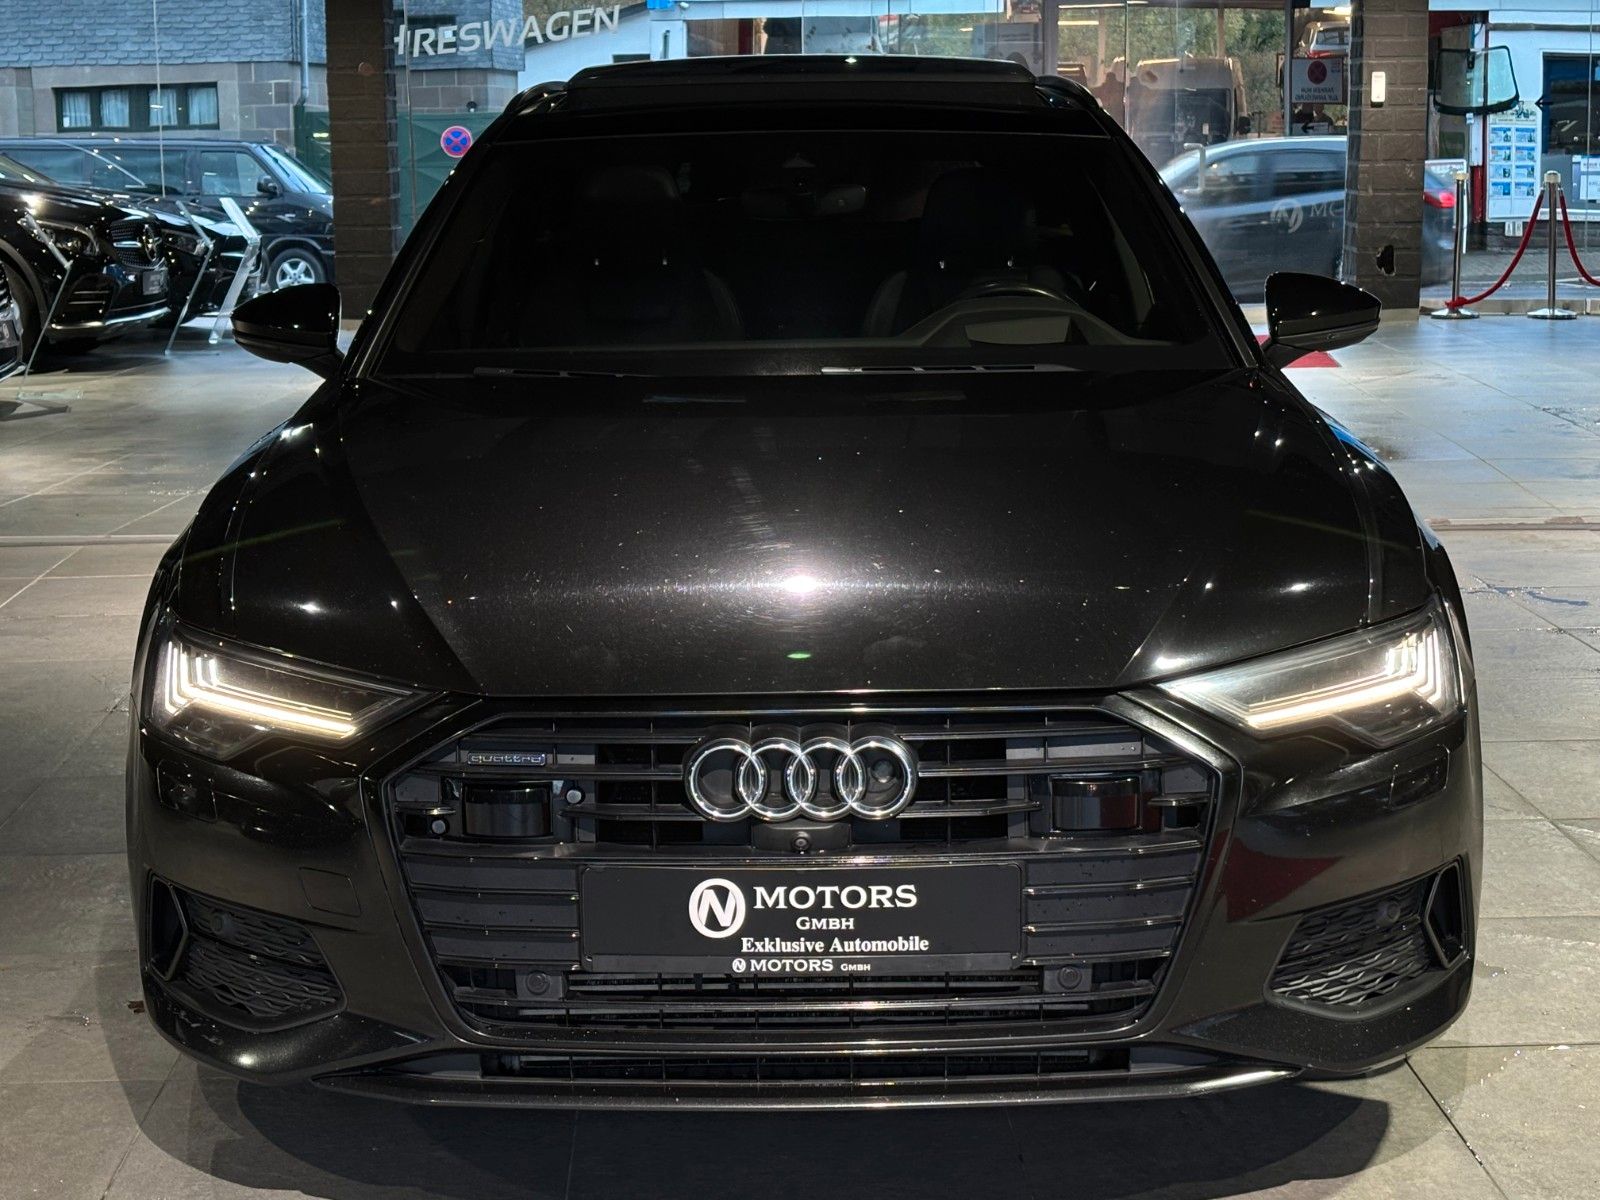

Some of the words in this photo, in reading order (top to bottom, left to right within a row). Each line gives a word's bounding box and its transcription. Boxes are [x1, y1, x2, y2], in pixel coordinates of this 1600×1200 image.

[471, 755, 541, 764] quattro
[752, 884, 918, 909] MOTORS
[796, 916, 855, 930] GMBH
[741, 937, 825, 953] Exklusive
[829, 936, 930, 953] Automobile
[750, 958, 834, 972] MOTORS
[840, 963, 872, 972] GMBH
